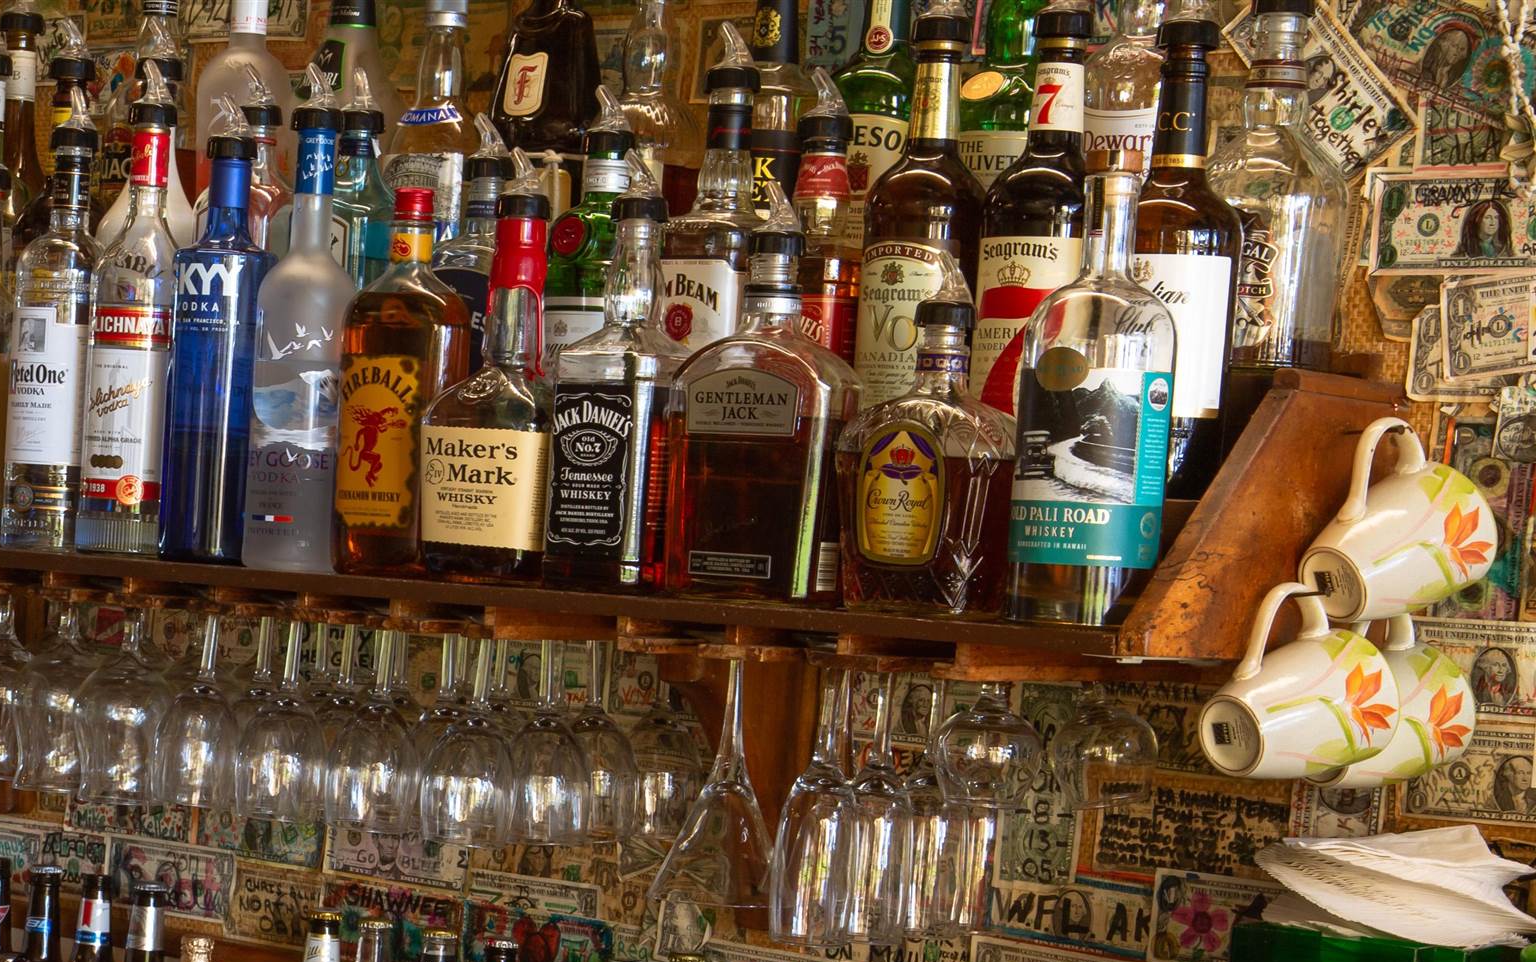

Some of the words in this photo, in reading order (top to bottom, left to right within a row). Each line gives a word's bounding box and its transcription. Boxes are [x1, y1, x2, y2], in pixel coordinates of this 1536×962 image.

[1358, 76, 1388, 109] AMERICA
[1037, 84, 1064, 125] 7
[960, 141, 983, 152] THE
[866, 245, 933, 262] IMPORTED
[982, 241, 1060, 262] Seagram's
[1441, 258, 1466, 267] ONE
[1468, 258, 1525, 268] DOLLAR
[178, 262, 244, 296] KYY
[675, 273, 719, 312] BEAM
[1479, 288, 1497, 299] THE
[1498, 285, 1531, 297] UNITE
[93, 314, 165, 337] LICHNAYA
[977, 327, 1018, 340] AMERI
[35, 364, 66, 386] One
[16, 386, 45, 396] VODKA
[342, 366, 412, 406] FIREBALL
[695, 391, 788, 406] GENTLEMAN
[552, 405, 581, 436] JACK
[582, 400, 634, 439] DANIEL'S
[722, 406, 759, 421] JACK
[575, 442, 601, 453] No.7
[581, 435, 596, 443] Old
[424, 436, 518, 460] Maker's
[266, 451, 329, 470] GOOSE
[446, 463, 516, 486] Mark
[560, 466, 614, 483] Tennessee
[436, 491, 498, 505] WHISKY
[560, 489, 612, 501] WHISKEY
[867, 488, 896, 510] Crown
[891, 490, 929, 512] Royal
[1030, 506, 1059, 522] PALI
[1064, 507, 1111, 524] ROAD
[1024, 525, 1075, 539] WHISKEY
[1424, 629, 1442, 639] THE
[1443, 630, 1478, 641] UNITED
[1479, 632, 1514, 643] STATES
[1514, 634, 1526, 643] OF
[1472, 738, 1502, 748] NITED
